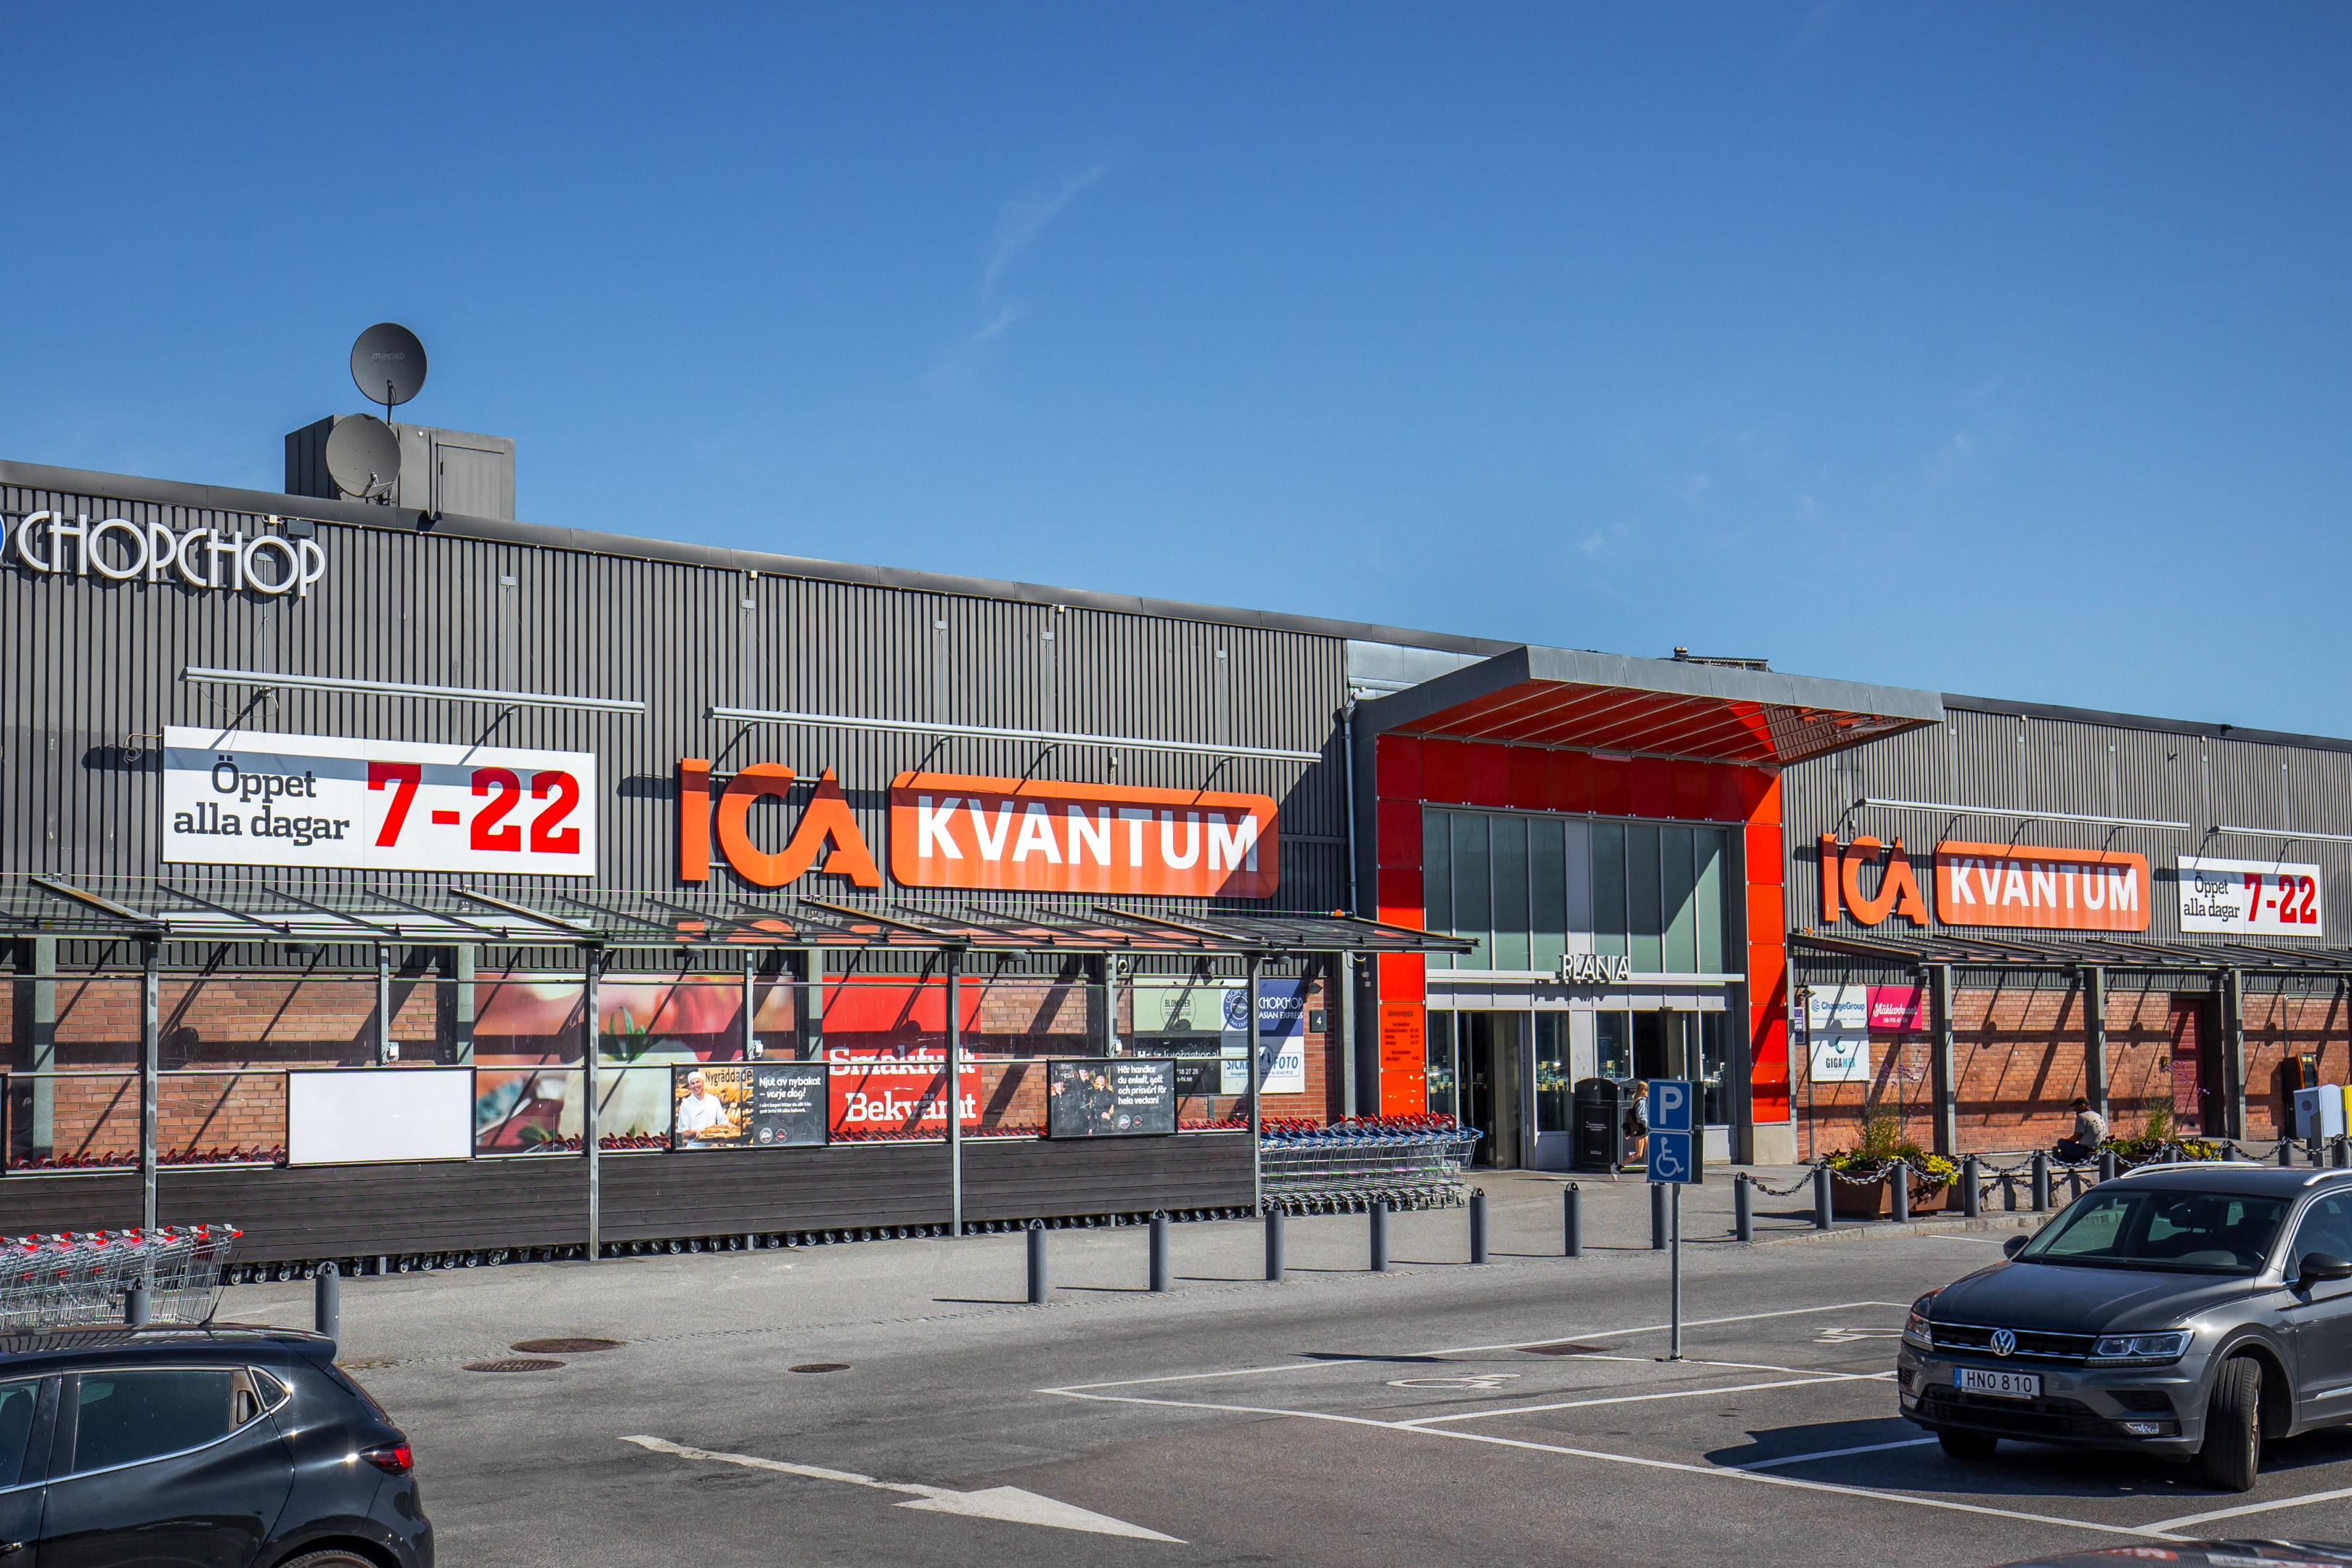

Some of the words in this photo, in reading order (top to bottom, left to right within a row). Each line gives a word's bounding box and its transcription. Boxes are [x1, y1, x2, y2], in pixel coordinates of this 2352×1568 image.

[372, 351, 405, 360] macab
[16, 510, 326, 597] CHOPCHOP
[211, 754, 317, 803] Öppet
[367, 760, 581, 855] 7-22
[173, 801, 242, 836] alla
[250, 805, 350, 846] dagar
[680, 757, 883, 887] ICA
[918, 796, 1257, 872] KVANTUM
[1821, 833, 1930, 926] ICA
[1950, 857, 2139, 912] KVANTUM
[2194, 871, 2229, 898] Öppet
[2184, 898, 2206, 917] alla
[2208, 899, 2240, 922] dagar
[2244, 873, 2317, 924] 7-22
[1563, 954, 1630, 981] PLANIA
[1258, 997, 1303, 1010] CHOPCHOP
[1821, 1001, 1866, 1012] ChangeGroup
[1316, 1016, 1322, 1025] 4
[1117, 1065, 1130, 1074] Här
[1131, 1065, 1156, 1074] handlar
[1273, 1056, 1299, 1070] FOTO
[759, 1077, 776, 1088] Njut
[788, 1076, 821, 1088] nybakat
[1118, 1086, 1130, 1095] och
[1130, 1085, 1157, 1096] prisvärt
[1157, 1085, 1167, 1094] för
[1149, 1075, 1163, 1086] gott
[767, 1088, 786, 1100] varje
[787, 1087, 806, 1100] dag!
[1133, 1096, 1159, 1105] veckan!
[1659, 1086, 1683, 1125] P
[1967, 1371, 1996, 1389] HNO
[2001, 1375, 2033, 1393] 810
